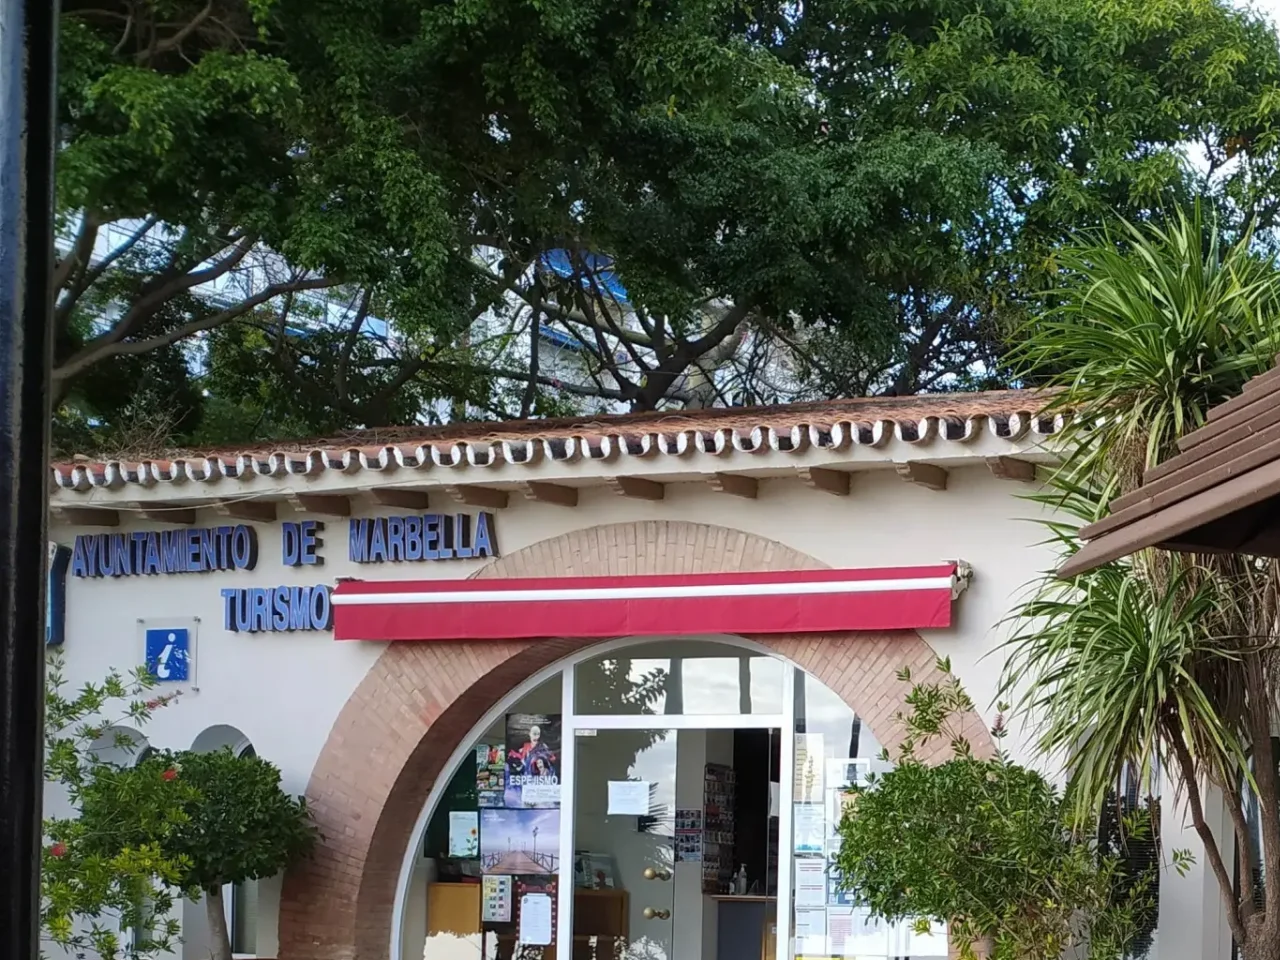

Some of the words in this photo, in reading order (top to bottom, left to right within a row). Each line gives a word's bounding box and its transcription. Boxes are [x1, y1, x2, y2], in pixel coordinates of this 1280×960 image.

[71, 524, 256, 577] AYUNTAMIENTO
[281, 520, 323, 566] DE
[349, 511, 497, 563] MARBELLA
[220, 583, 333, 632] TURISMO
[509, 774, 558, 786] ESPEJISMO
